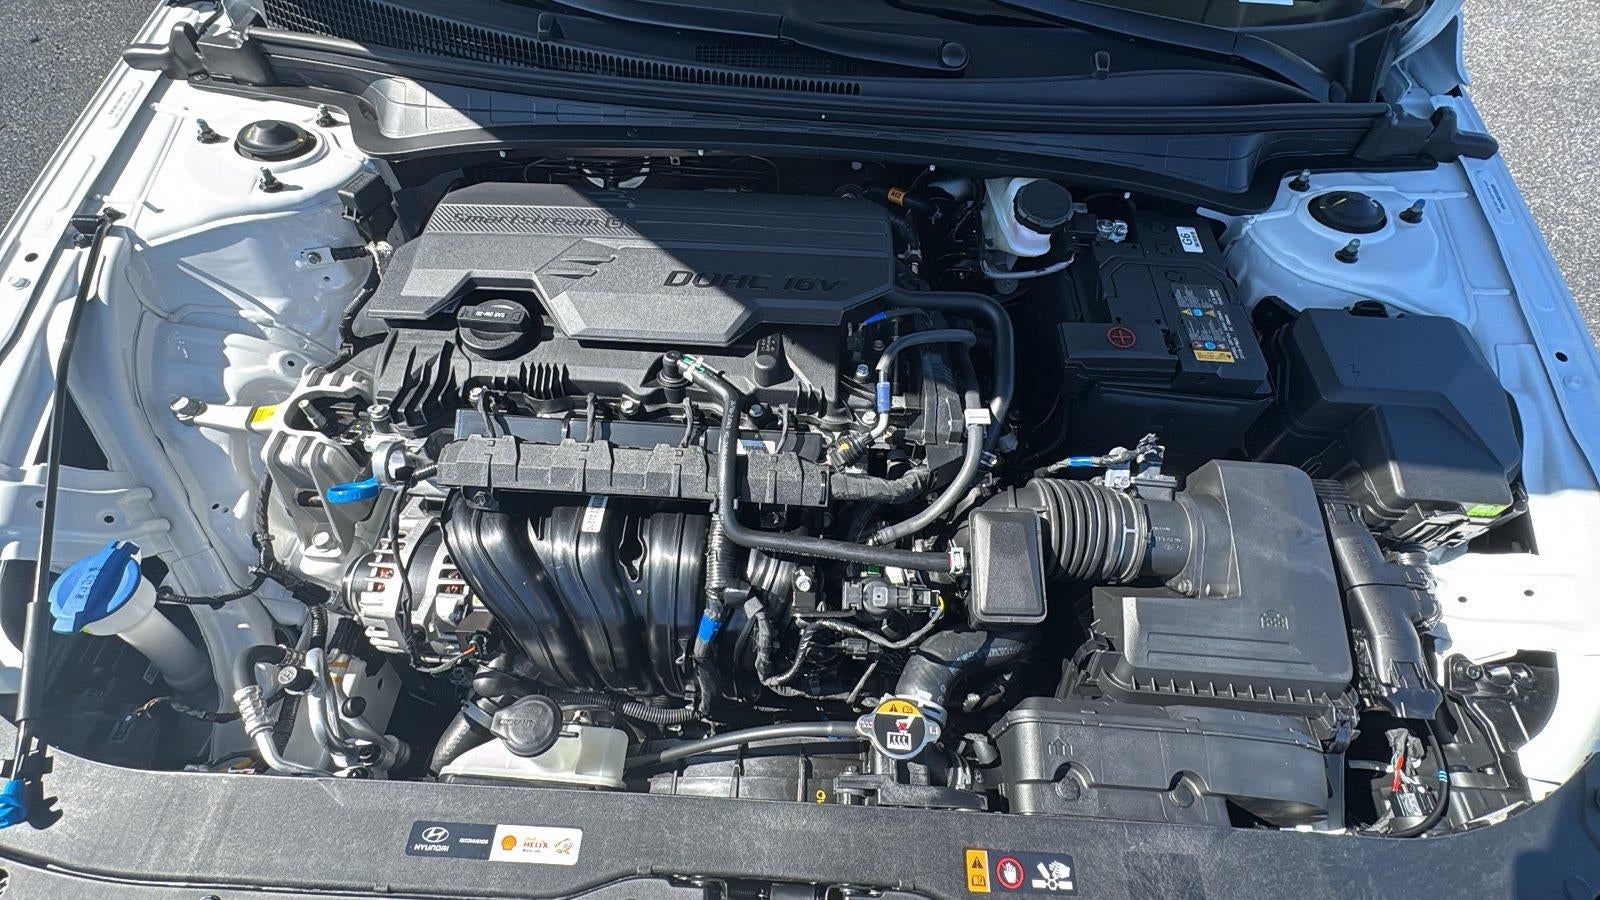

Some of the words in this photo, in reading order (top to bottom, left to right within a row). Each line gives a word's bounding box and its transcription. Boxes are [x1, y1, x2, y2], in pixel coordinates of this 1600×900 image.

[452, 211, 601, 226] Smartstream
[1180, 232, 1193, 245] G6
[663, 270, 774, 290] DOHC
[781, 275, 848, 293] 16V
[413, 843, 450, 852] HYUNDAI
[523, 840, 549, 849] HELIX
